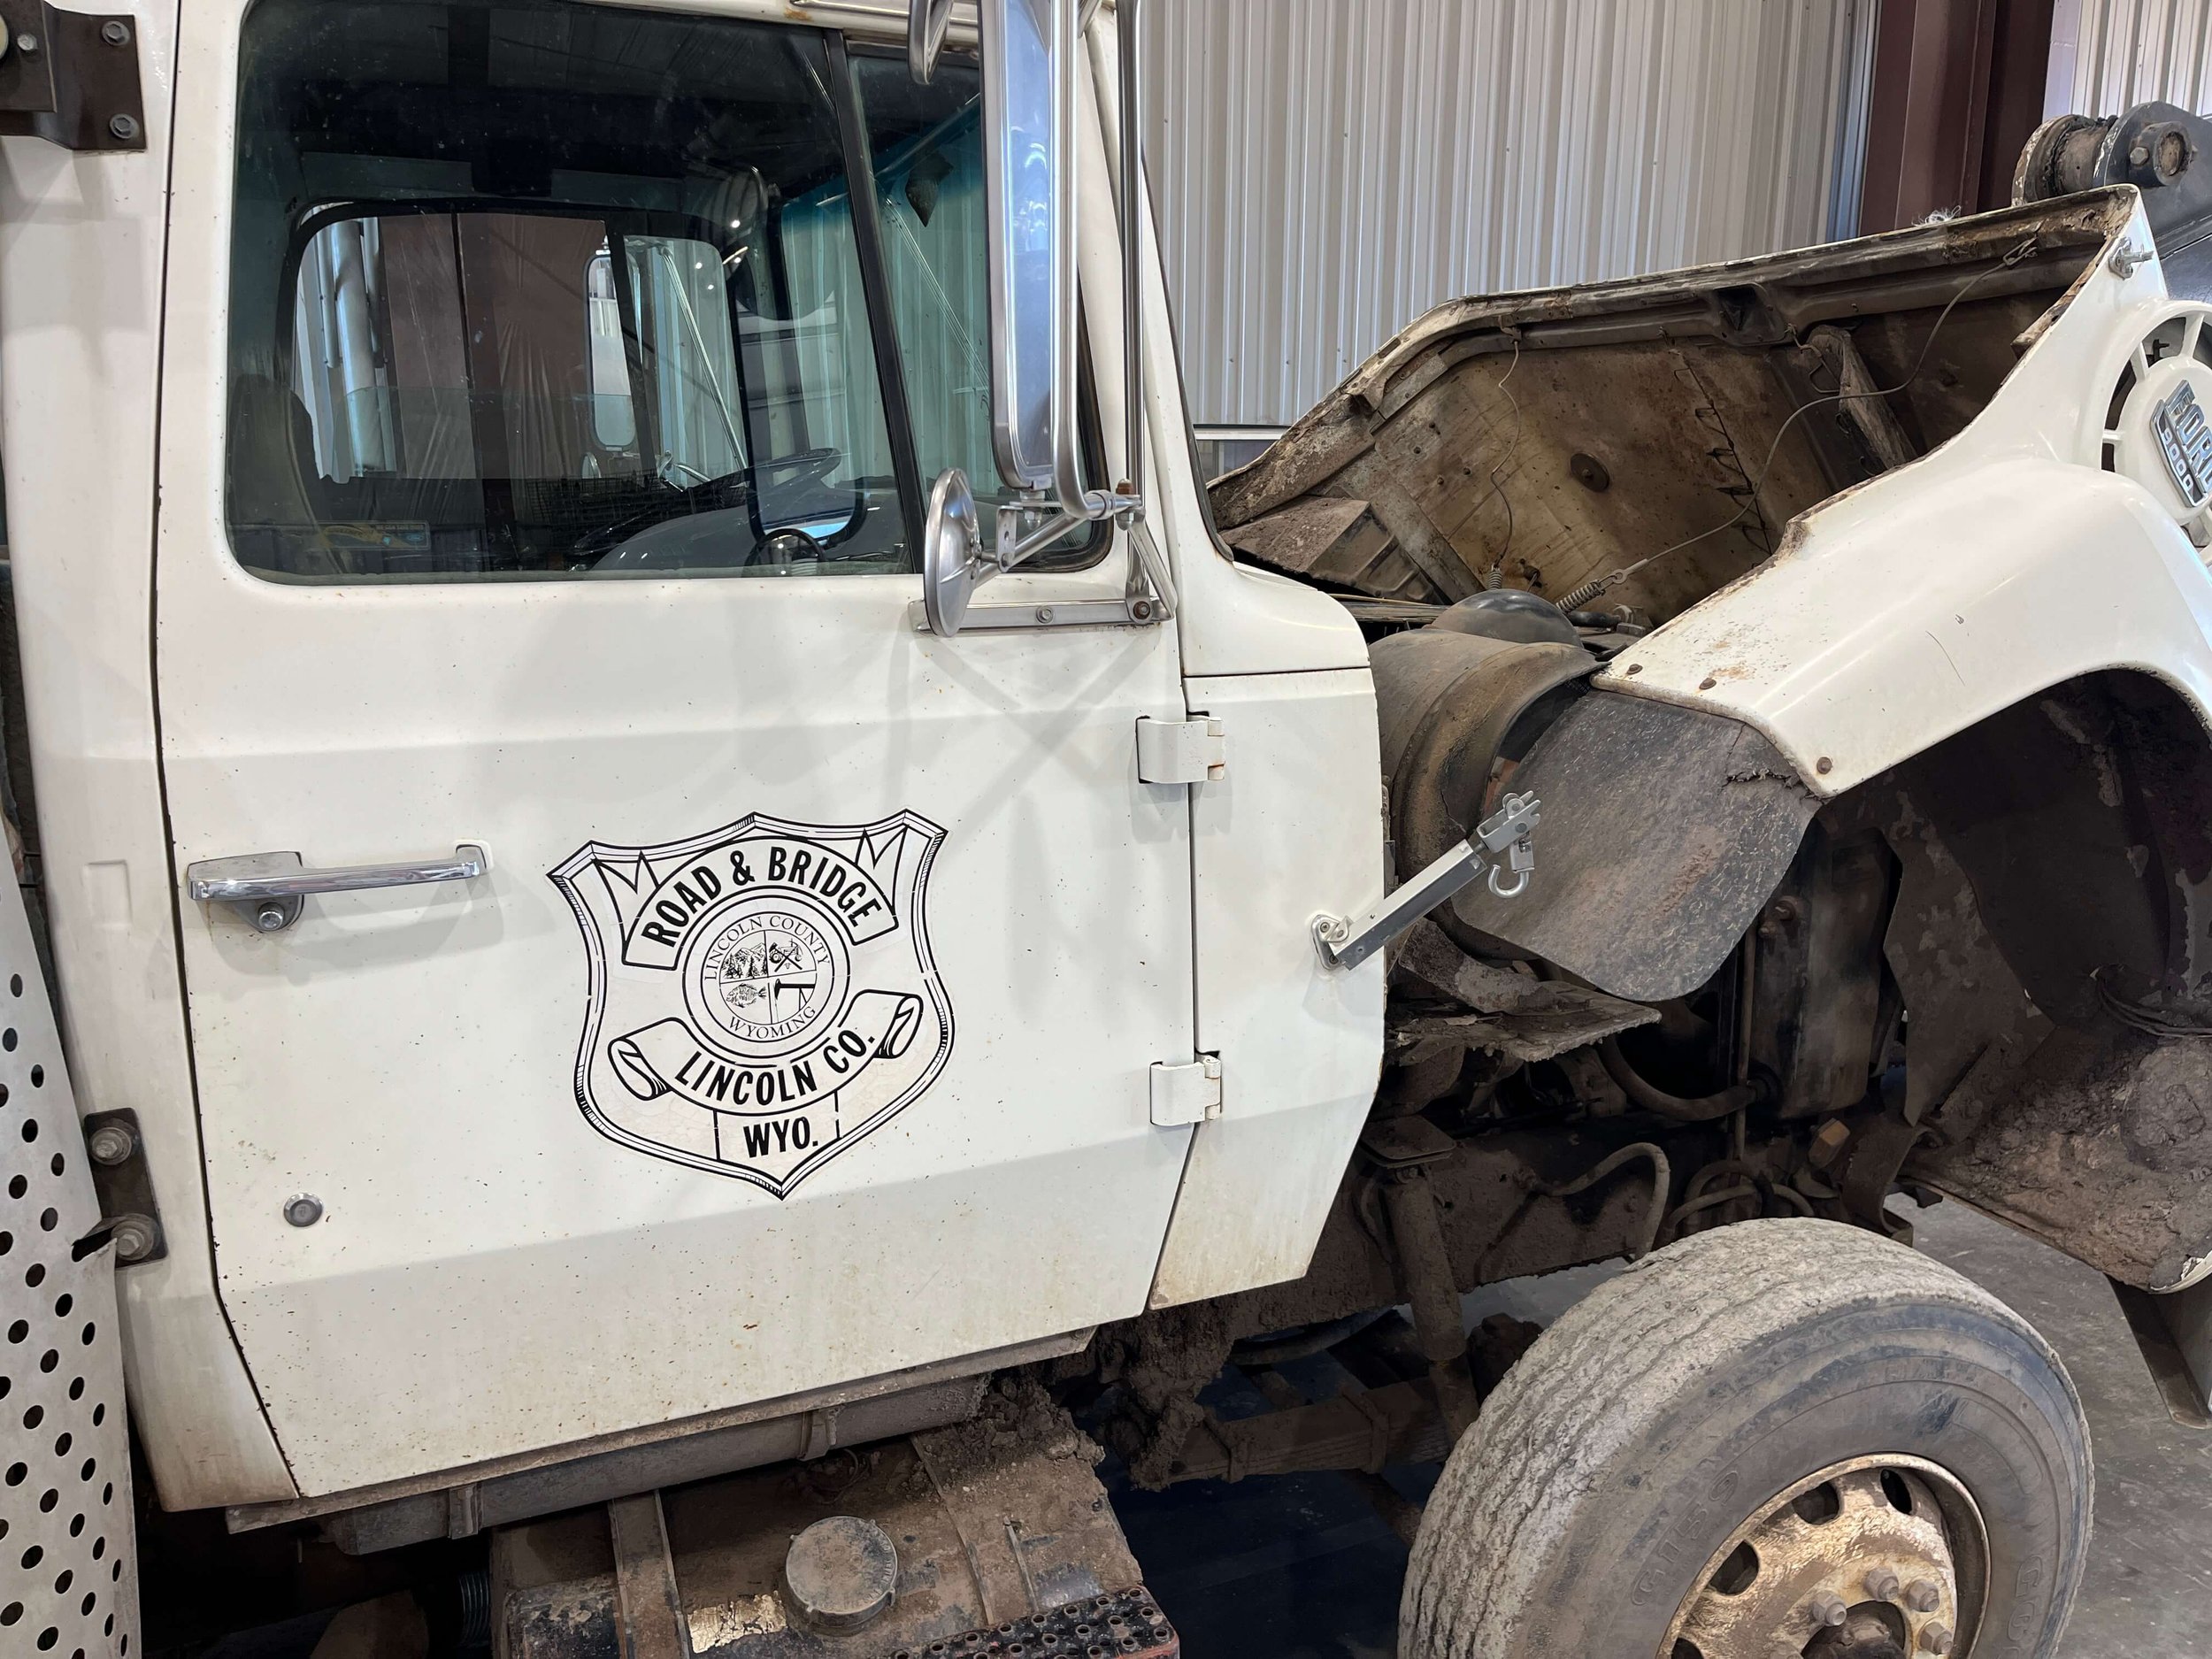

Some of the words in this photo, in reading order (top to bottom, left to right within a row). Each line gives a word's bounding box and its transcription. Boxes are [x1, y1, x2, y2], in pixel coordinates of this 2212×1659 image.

[2162, 427, 2193, 492] 9000
[641, 865, 721, 948] ROAD
[731, 849, 755, 886] &
[768, 846, 881, 927] BRIDGE
[704, 916, 763, 980] LINCOLN
[769, 915, 830, 964] COUNTY
[728, 1006, 816, 1039] WYOMING
[674, 1051, 818, 1106] LINCOLN
[824, 1030, 875, 1074] CO.
[743, 1116, 818, 1158] WYO.
